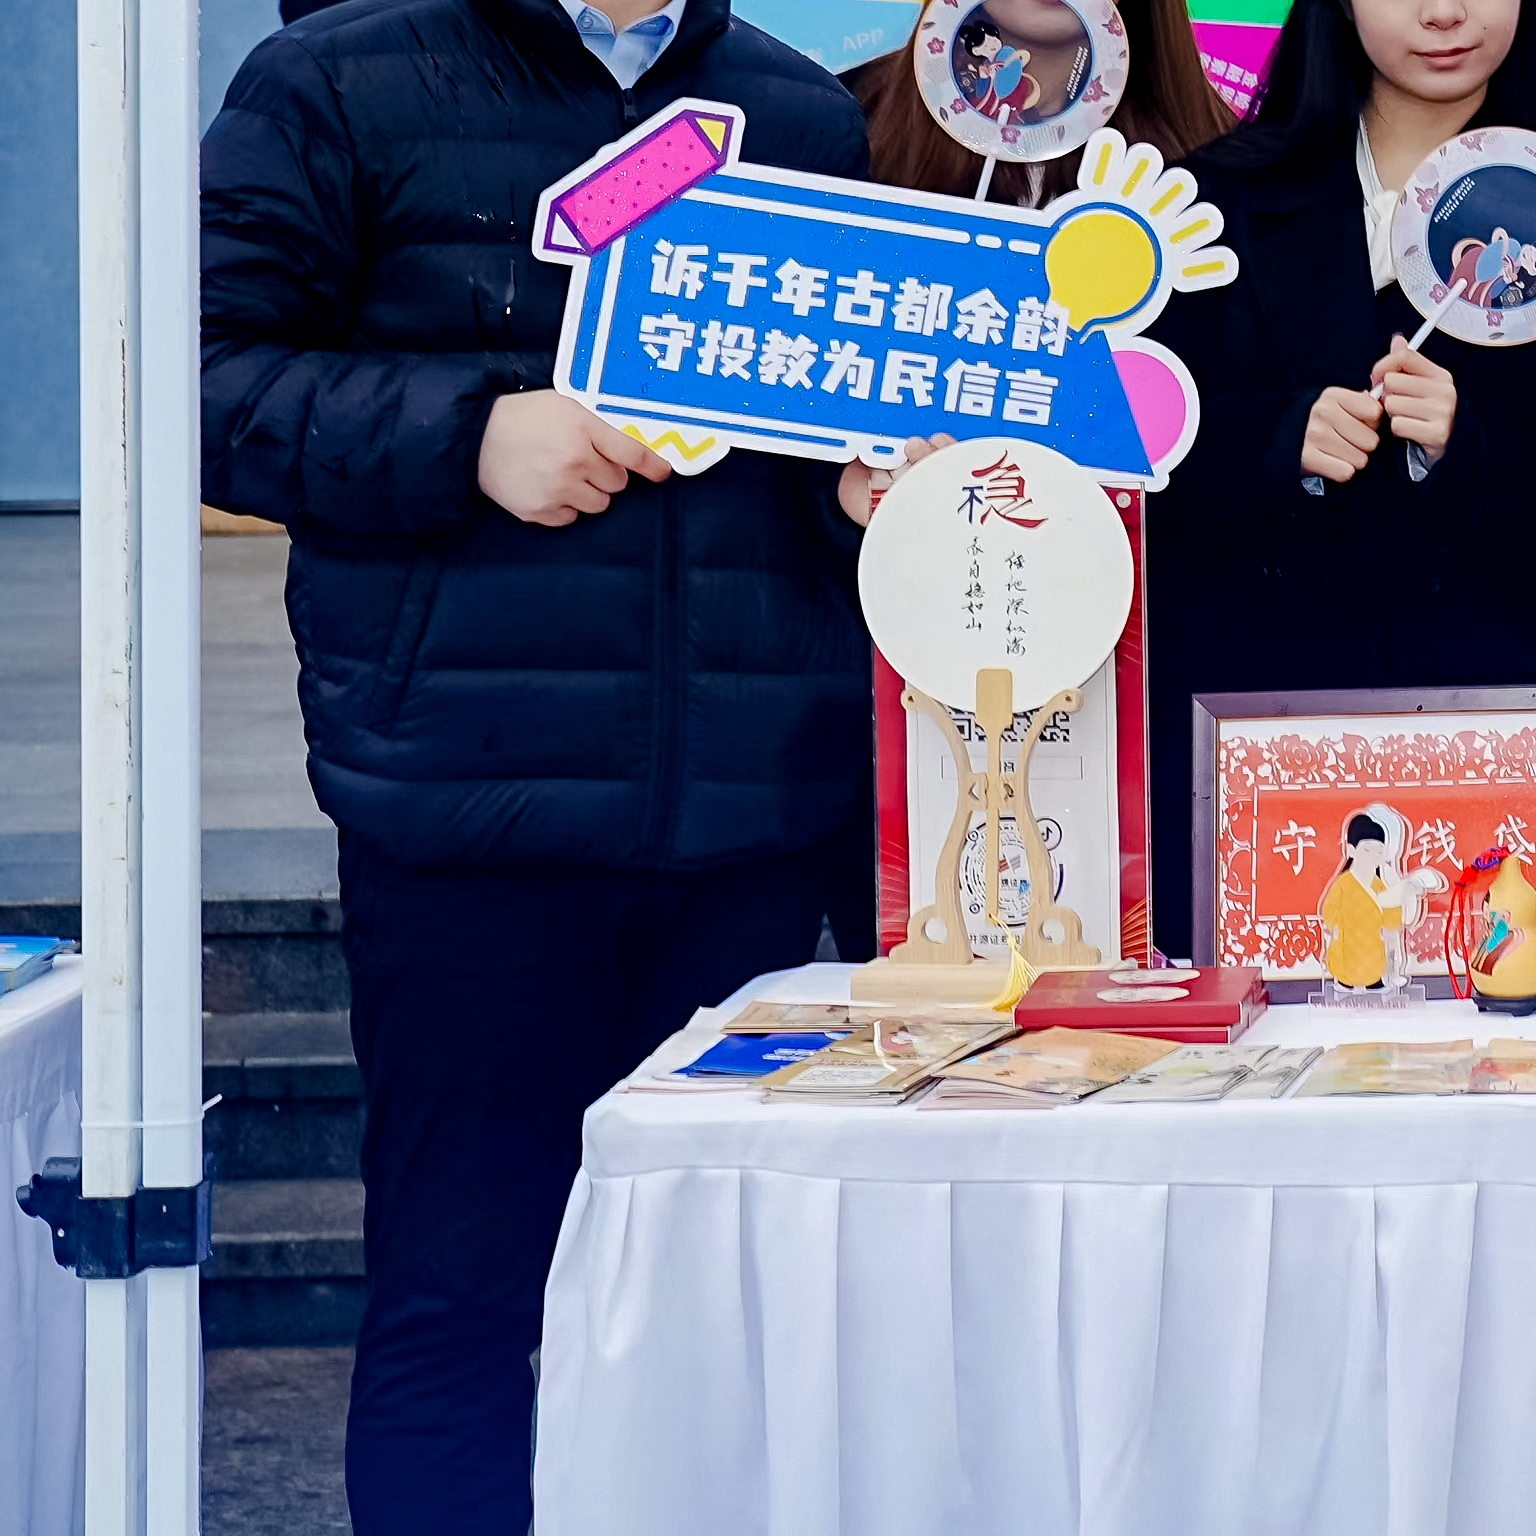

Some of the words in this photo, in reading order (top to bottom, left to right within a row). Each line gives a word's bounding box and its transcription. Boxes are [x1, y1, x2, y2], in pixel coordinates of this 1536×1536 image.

[651, 238, 1073, 357] 诉千年古都余韵
[638, 314, 1060, 426] 守投教为民信言
[1273, 814, 1536, 876] 守钱袋
